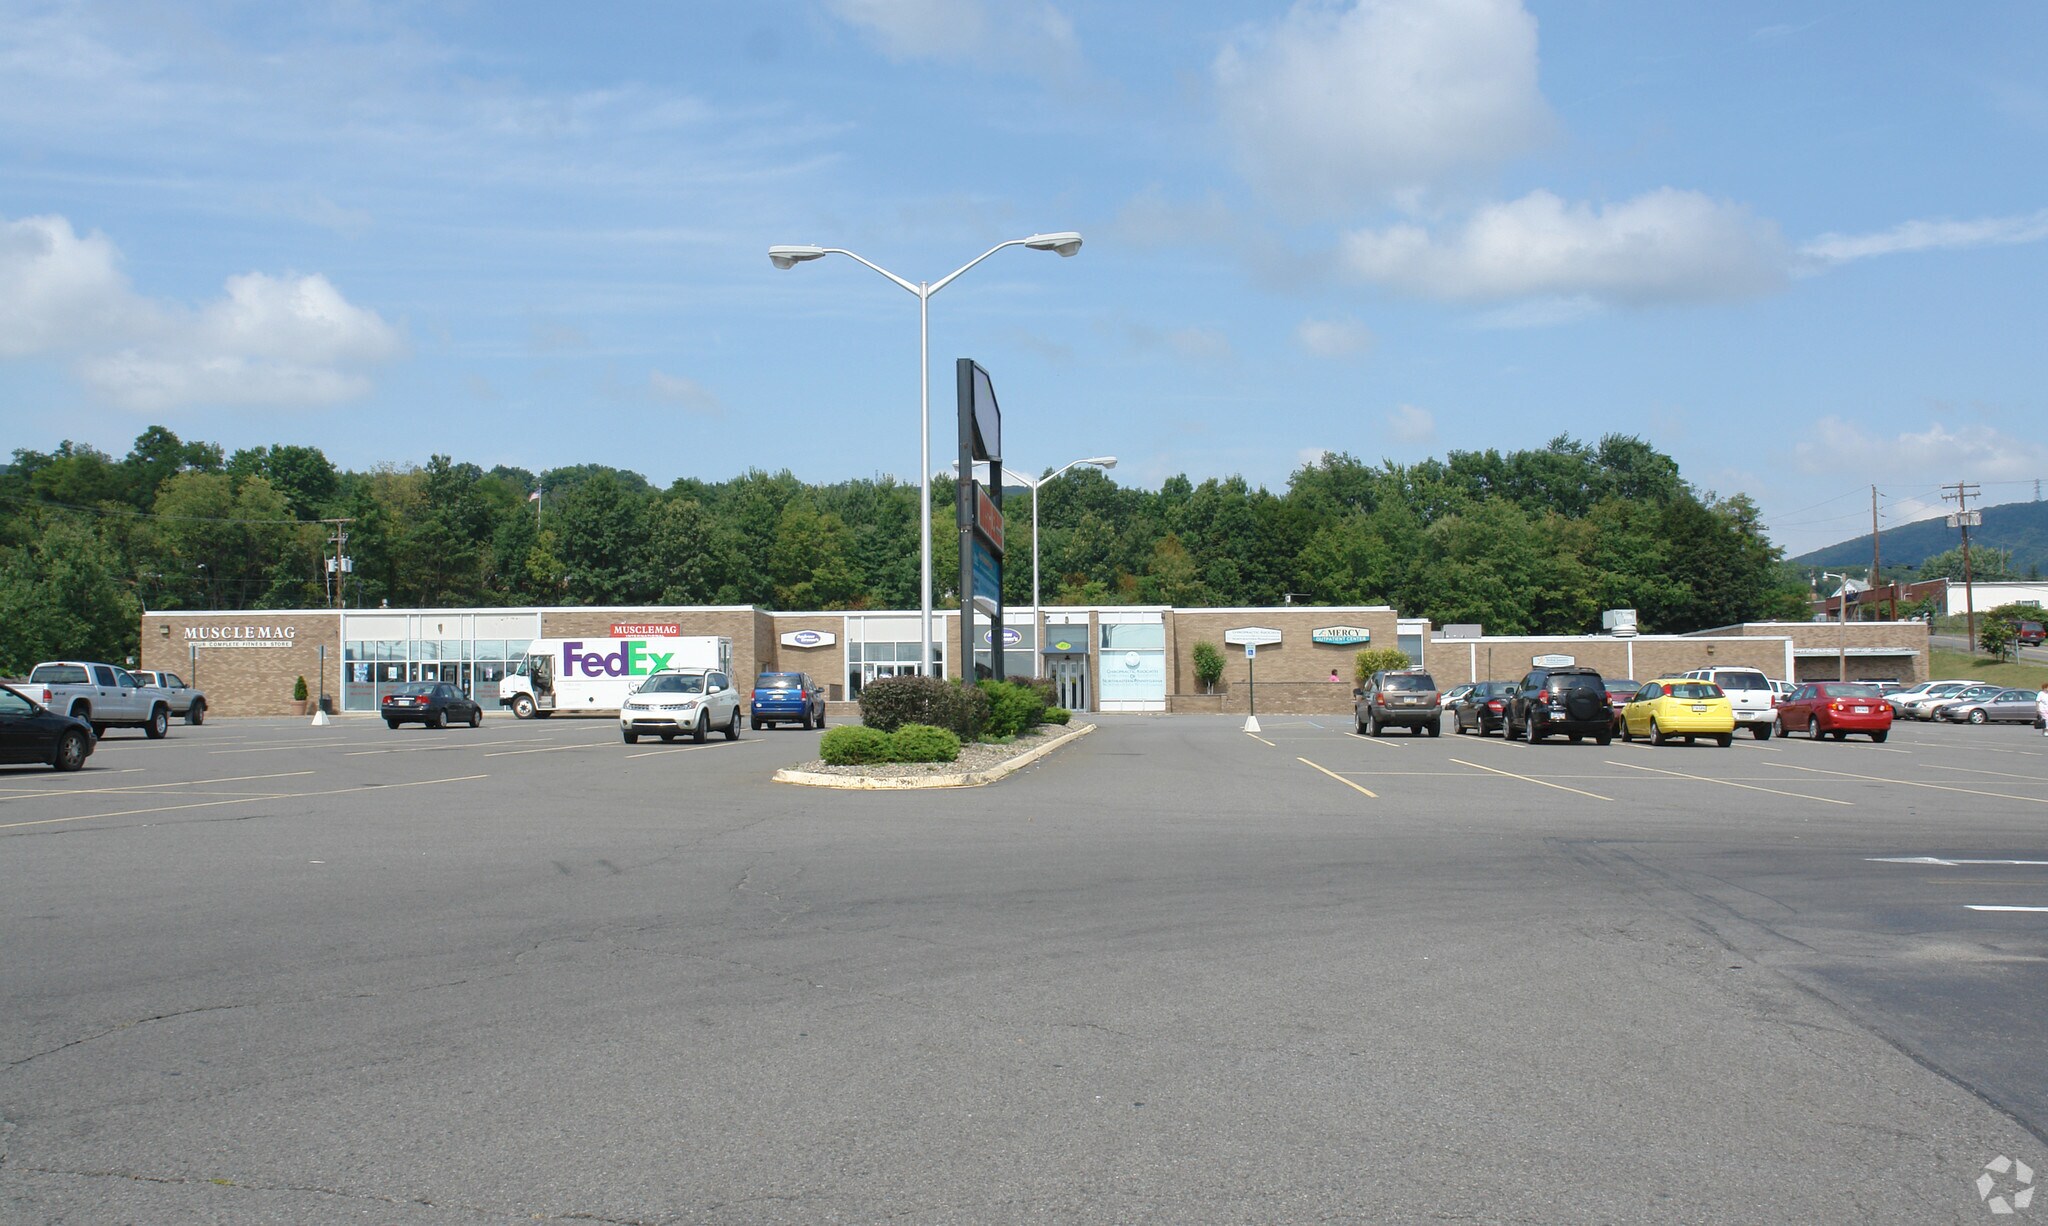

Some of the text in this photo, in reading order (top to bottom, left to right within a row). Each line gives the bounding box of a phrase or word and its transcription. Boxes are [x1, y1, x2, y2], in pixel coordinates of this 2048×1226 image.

[184, 626, 296, 639] MUSCLEMAG
[614, 626, 677, 634] MUSCLEMAG
[563, 641, 675, 678] FedEx
